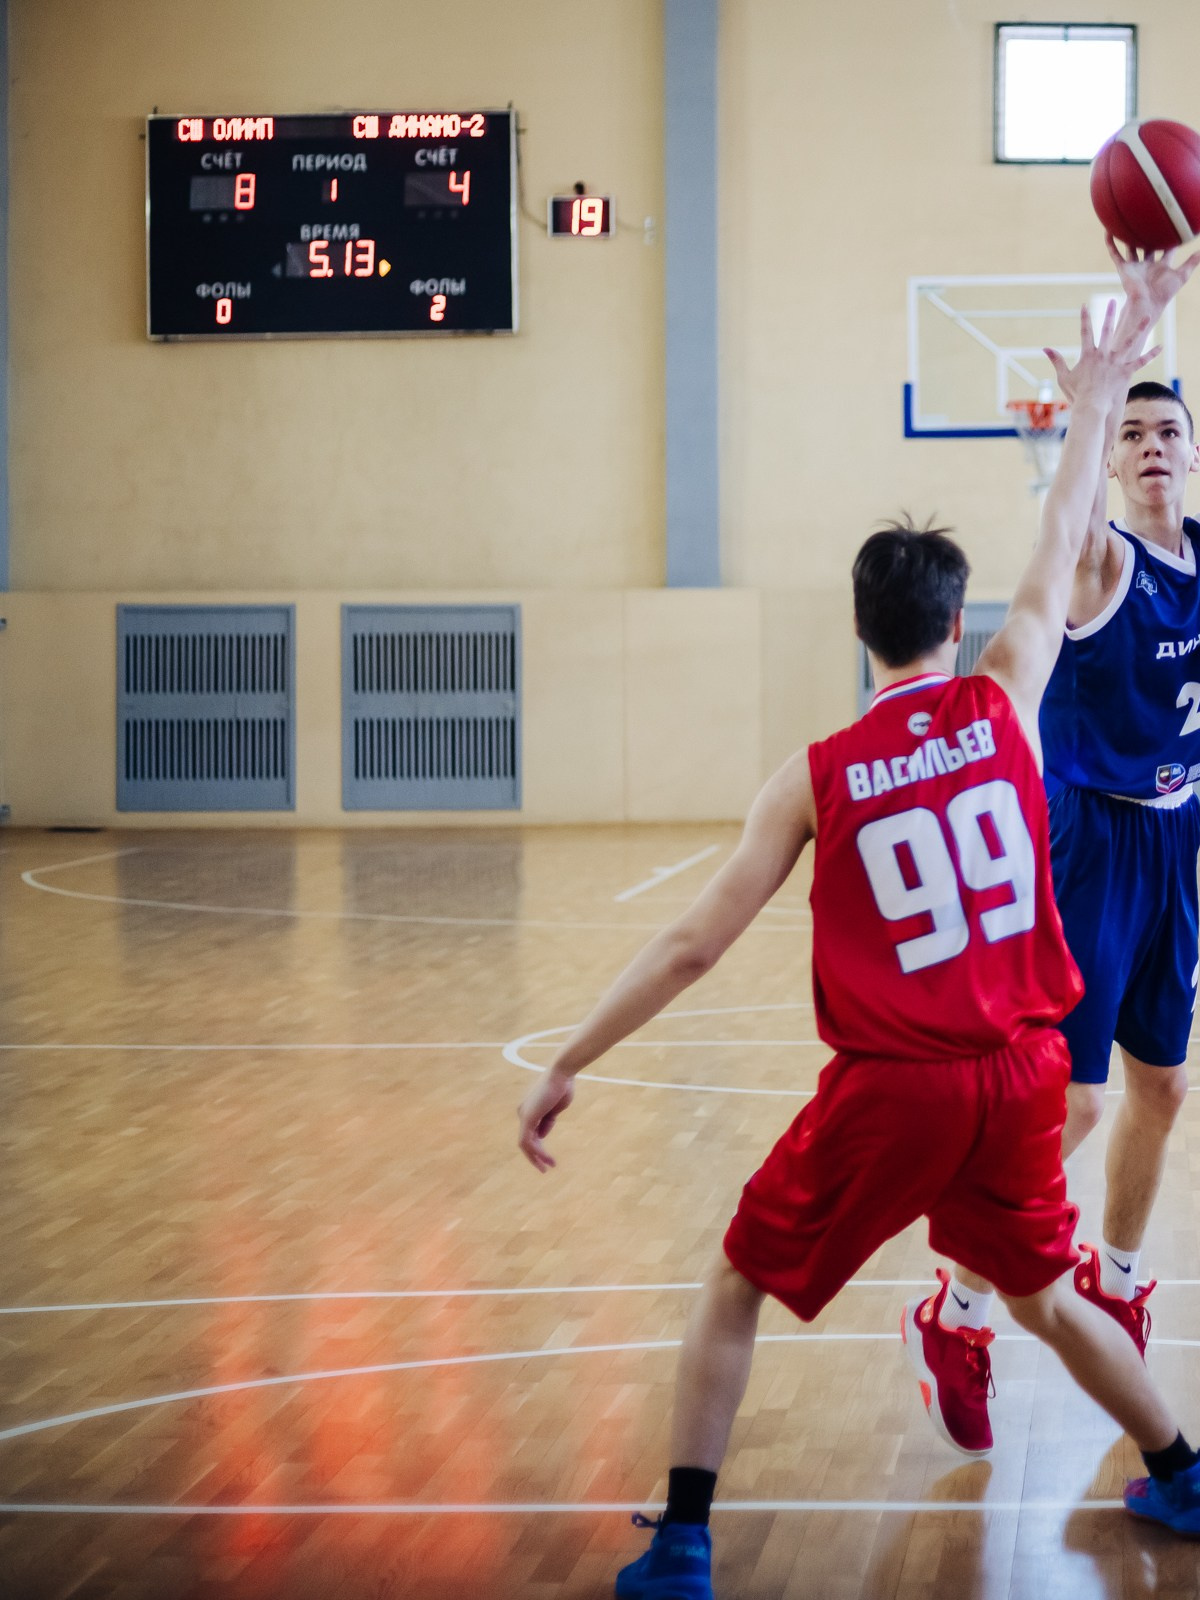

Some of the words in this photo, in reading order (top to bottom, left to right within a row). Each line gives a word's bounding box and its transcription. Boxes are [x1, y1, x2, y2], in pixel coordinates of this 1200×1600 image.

[178, 118, 204, 142] СШ
[213, 117, 274, 141] ОЛИМП
[353, 115, 379, 139] СШ
[292, 153, 367, 172] ПЕРИОД
[234, 173, 256, 211] 8
[331, 178, 338, 202] 1
[448, 170, 471, 206] 4
[571, 198, 603, 236] 19
[300, 223, 360, 241] ВРЕМЯ
[196, 281, 252, 298] ФОЛЫ
[410, 278, 466, 296] ФОЛЫ
[216, 297, 232, 325] 0
[429, 294, 446, 322] 2
[846, 719, 996, 801] ВАСИЛЬЕВ
[856, 779, 1036, 975] 99
